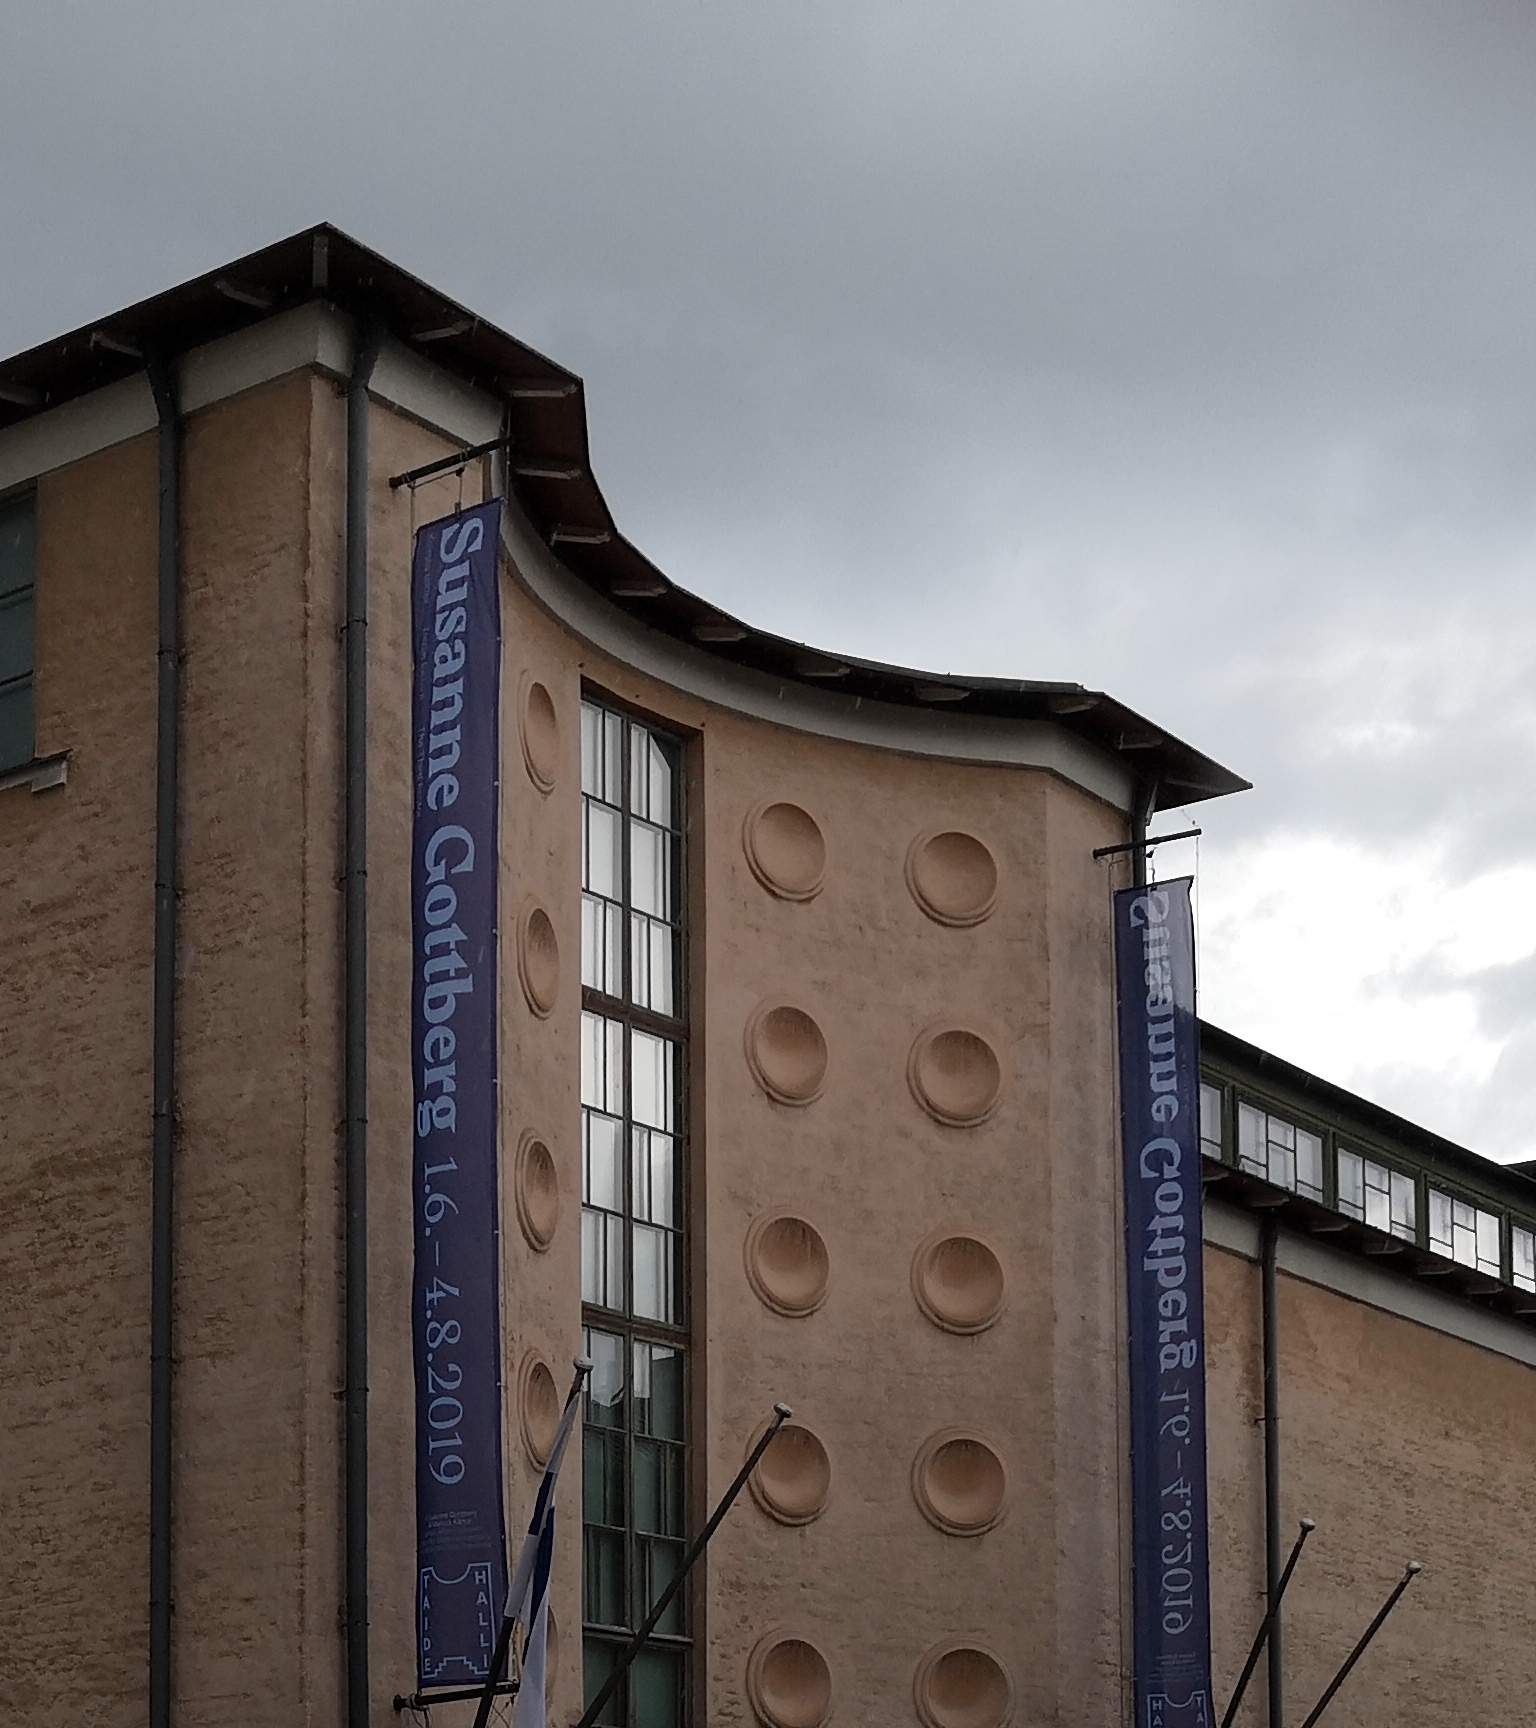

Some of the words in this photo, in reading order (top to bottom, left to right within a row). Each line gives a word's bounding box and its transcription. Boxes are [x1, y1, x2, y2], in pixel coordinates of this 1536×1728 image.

[426, 517, 484, 811] Susanne
[417, 824, 476, 1138] Gottberg
[423, 1575, 432, 1672] TAIDE
[474, 1570, 489, 1668] HALLI
